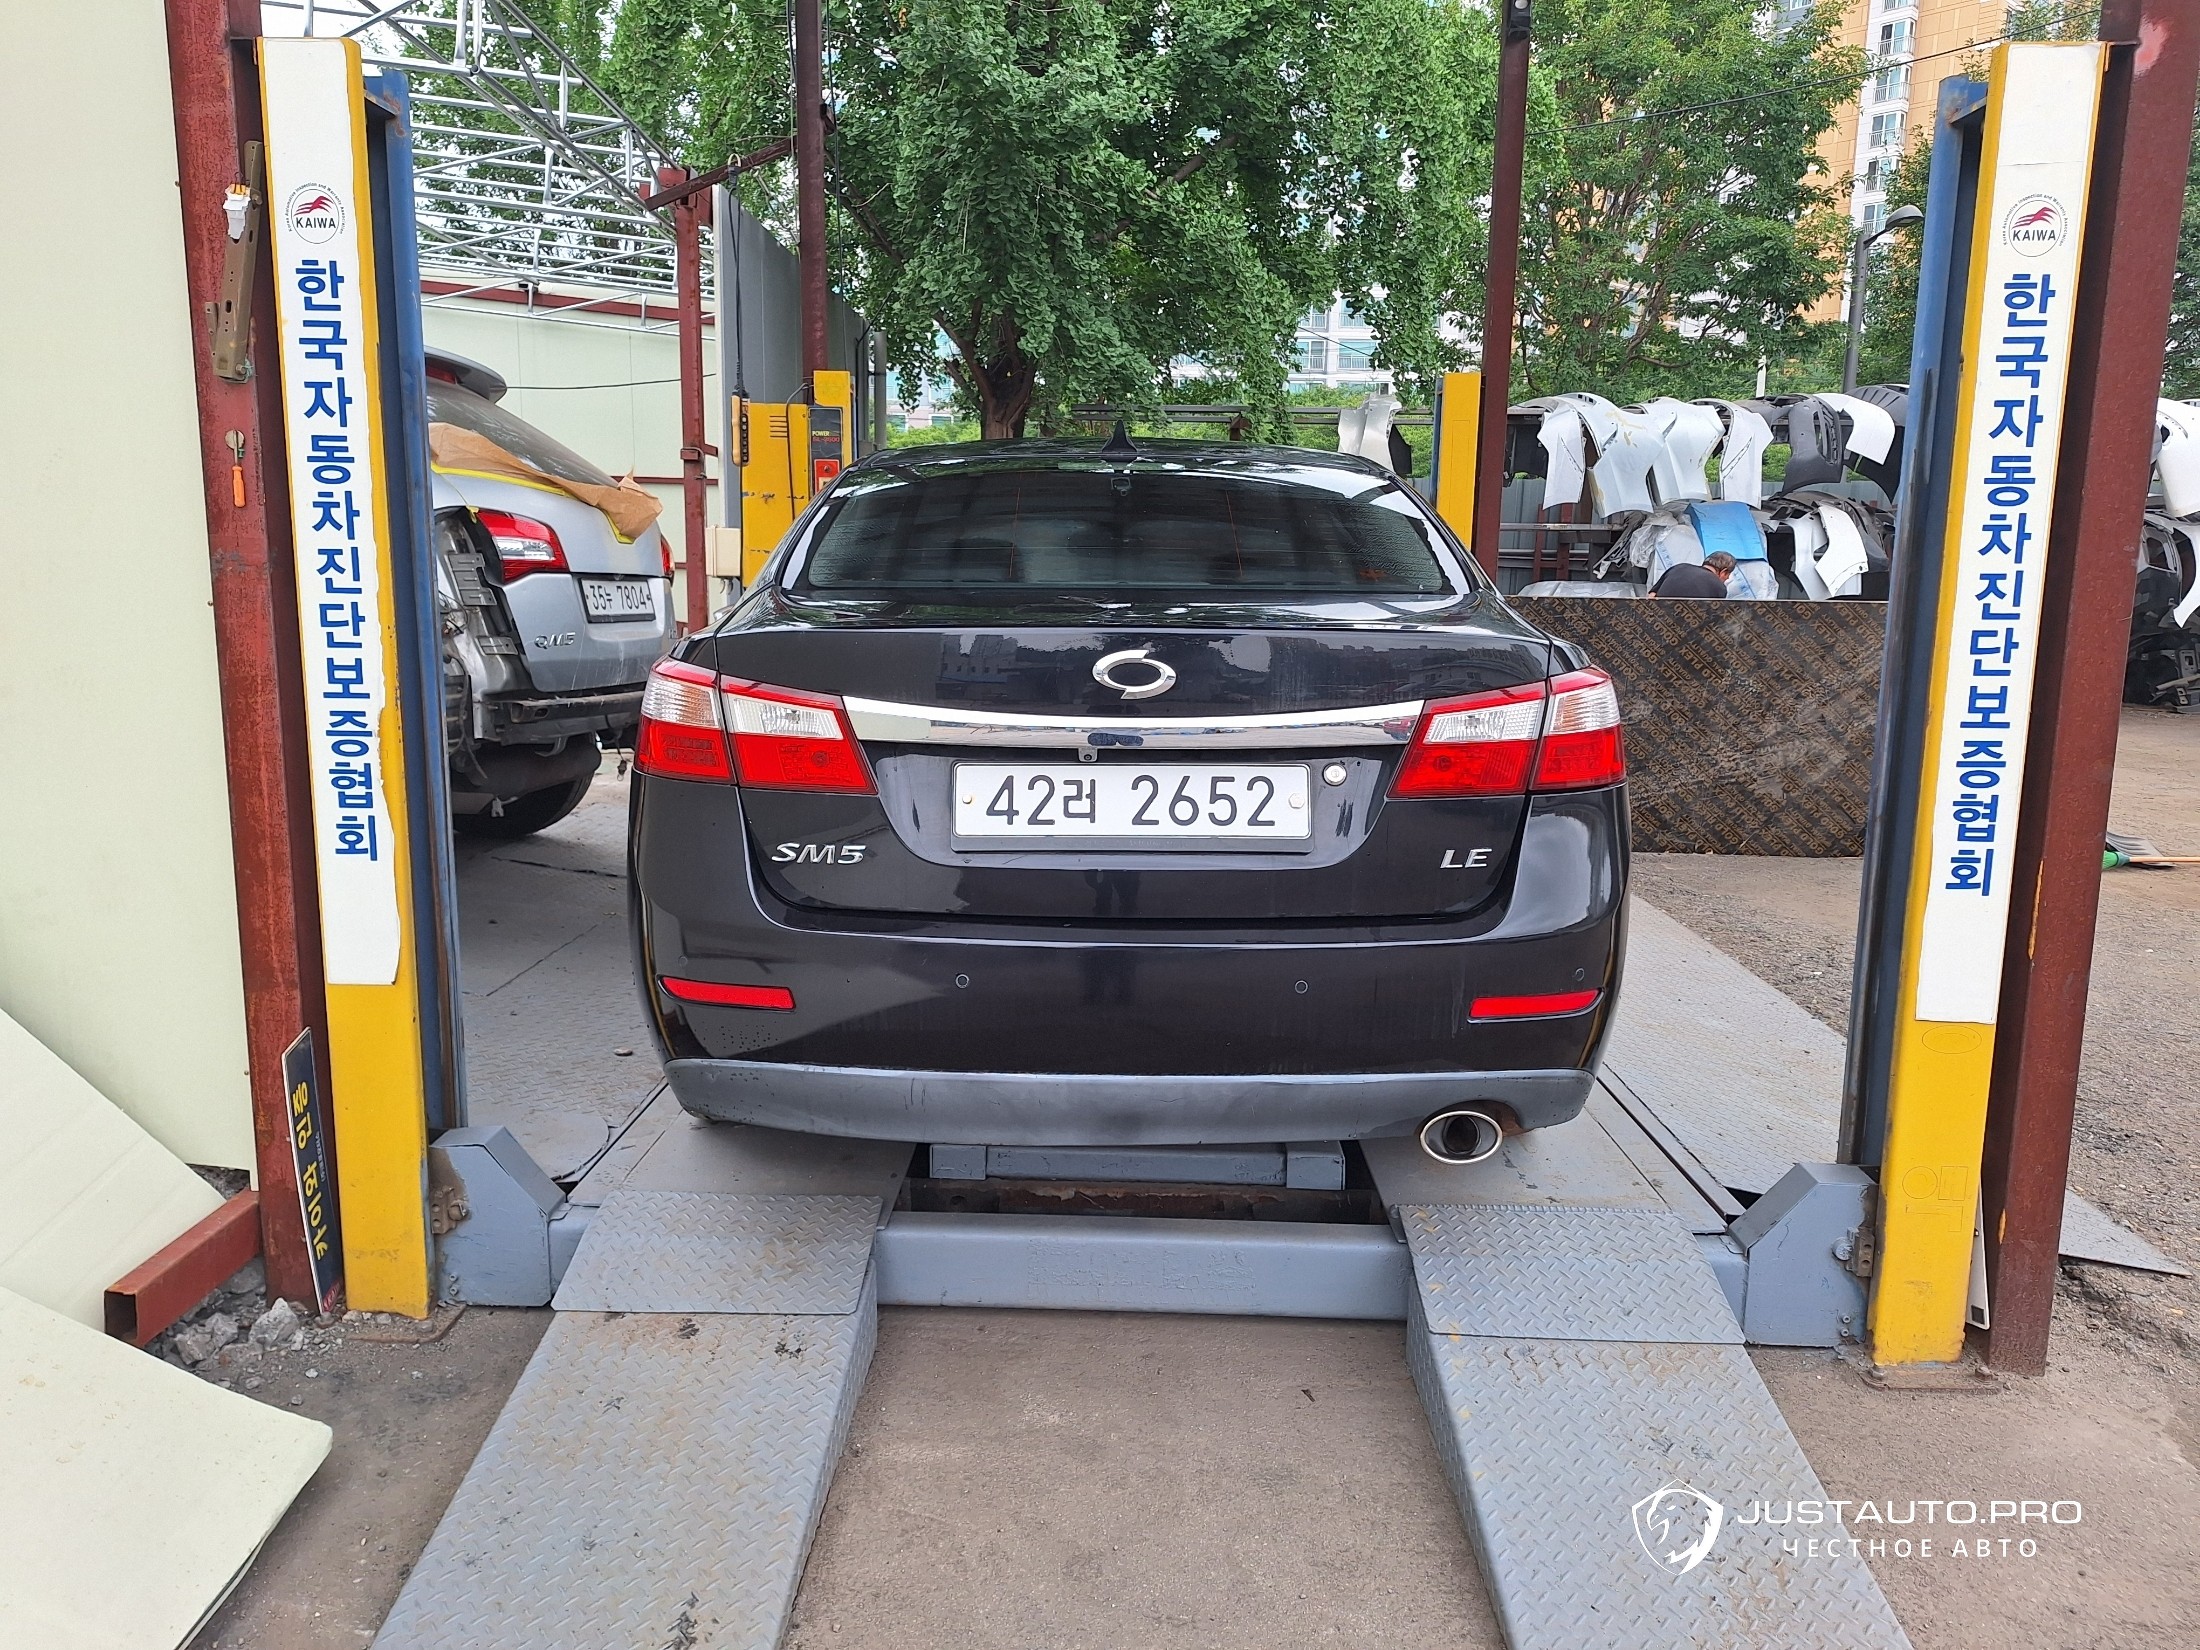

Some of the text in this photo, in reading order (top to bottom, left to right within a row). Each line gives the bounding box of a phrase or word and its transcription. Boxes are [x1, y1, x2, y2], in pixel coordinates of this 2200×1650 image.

[296, 217, 336, 228] KAIWA
[2012, 230, 2056, 242] KAIWA
[295, 259, 378, 862] 한국자동차진단보증협회
[1945, 273, 2056, 897] 한국자동차진단보증협회
[589, 585, 648, 610] 35누 7804
[534, 632, 576, 650] QM5
[1697, 627, 1725, 652] PLEX
[1809, 618, 1837, 644] PLEX
[1677, 645, 1704, 670] PLEX
[986, 774, 1276, 827] 42러 2652
[1840, 800, 1866, 824] GOLD
[1819, 815, 1845, 839] GOLD
[771, 842, 866, 864] SM5
[1798, 831, 1824, 855] GOLD
[1440, 848, 1492, 868] LE
[292, 1081, 328, 1260] 카이와 인증
